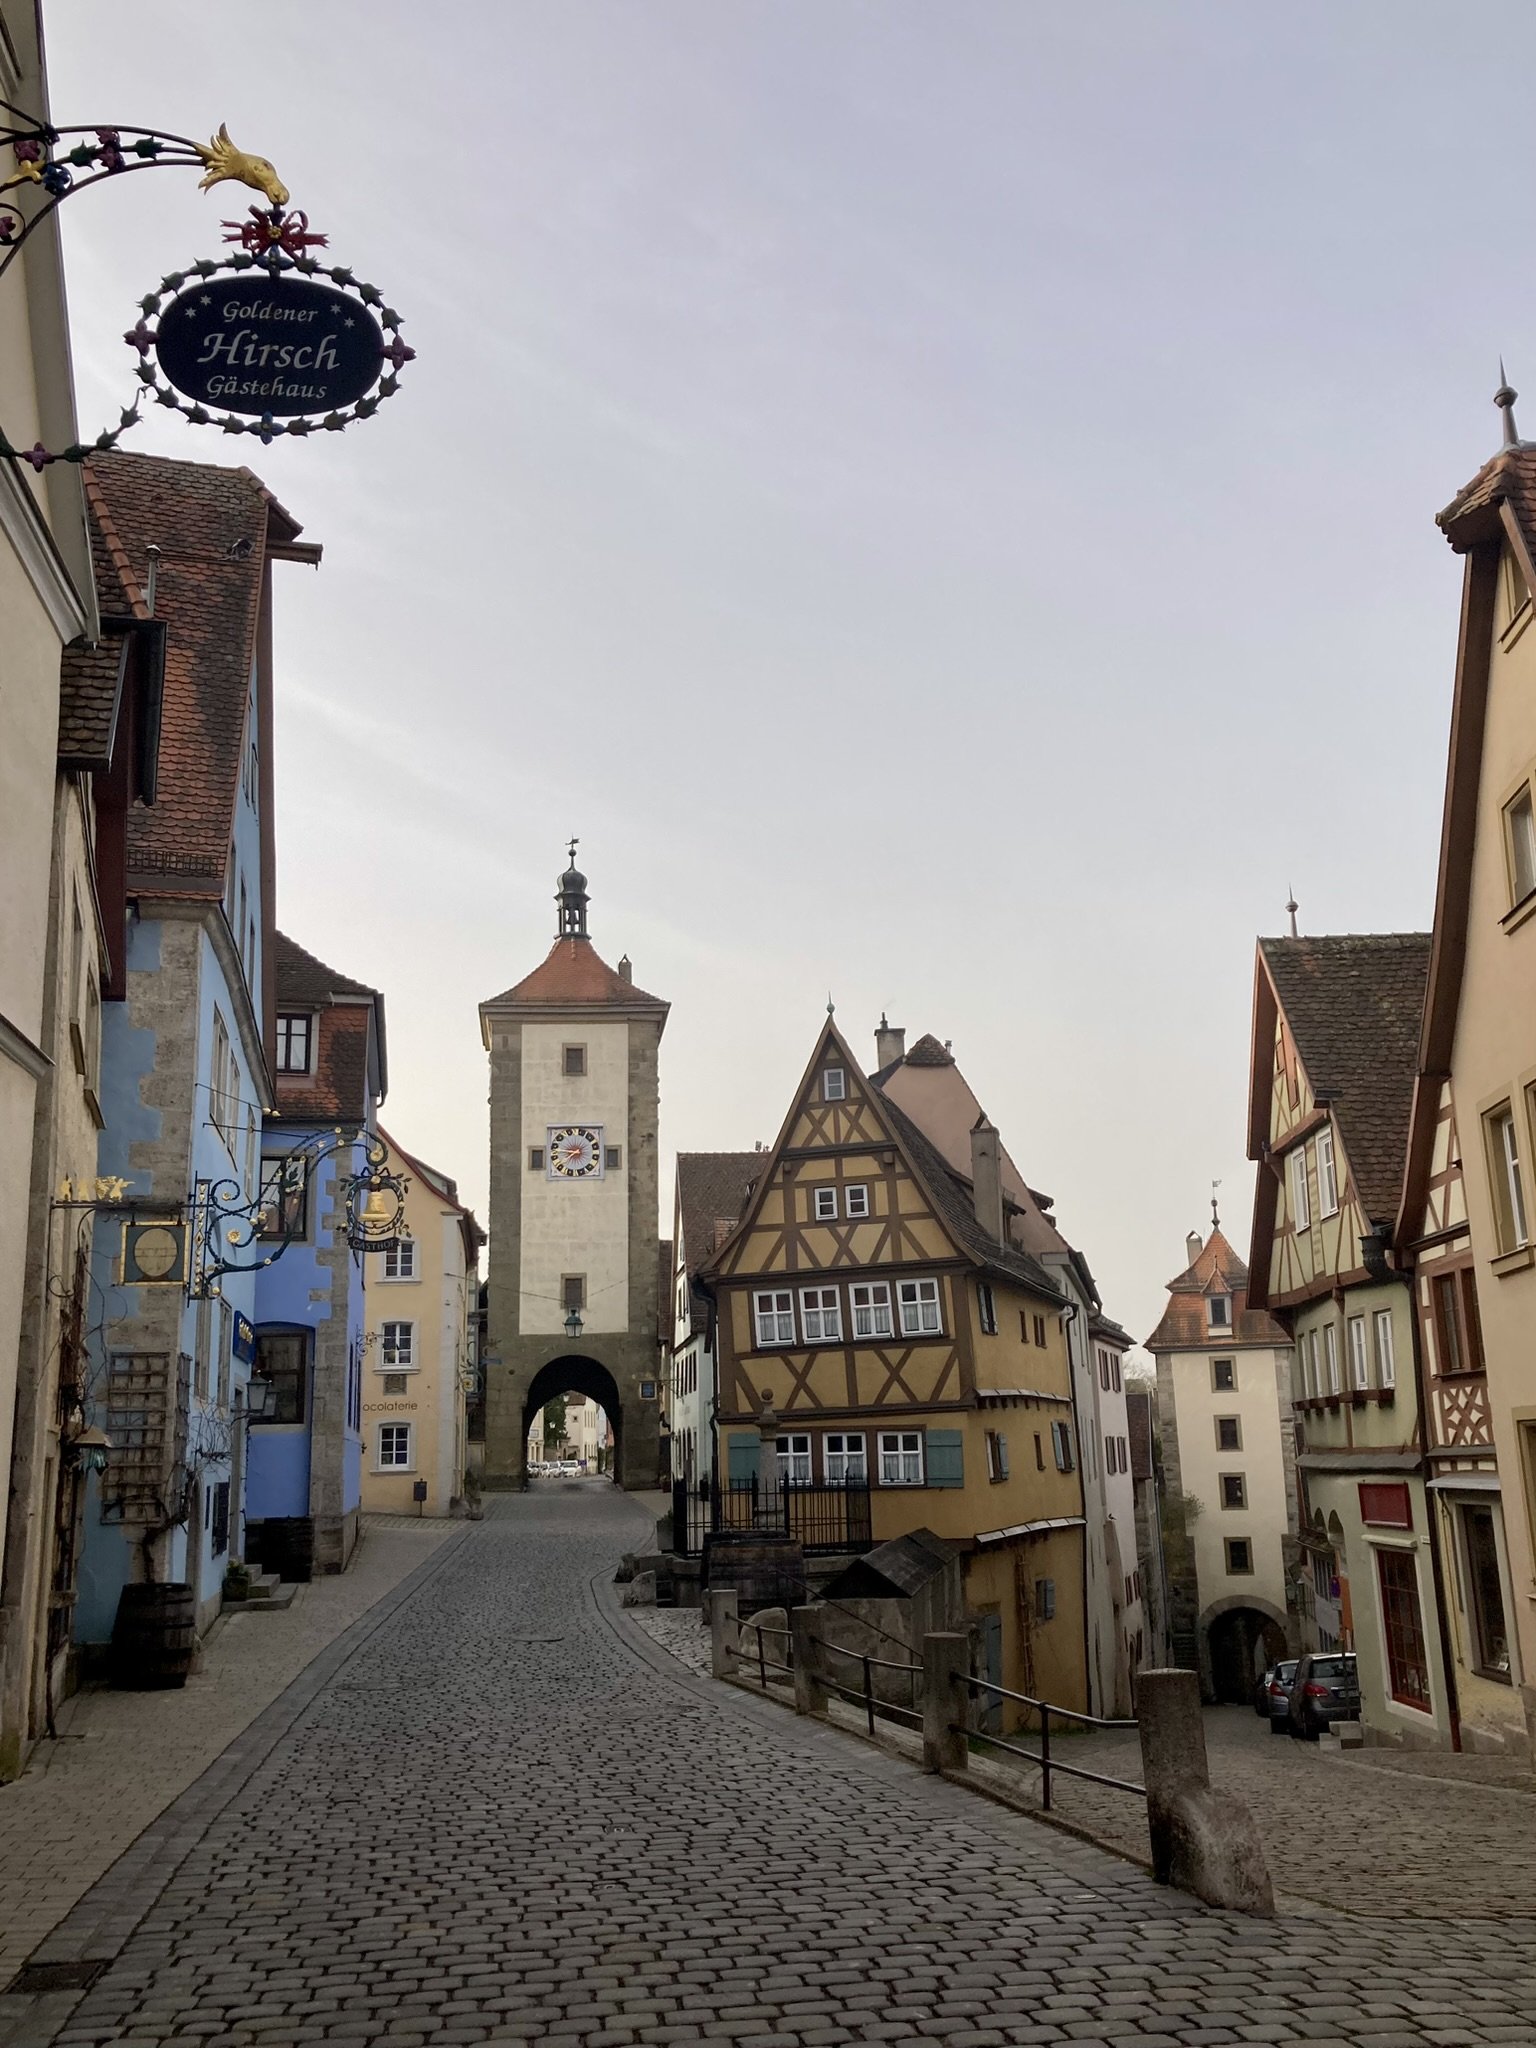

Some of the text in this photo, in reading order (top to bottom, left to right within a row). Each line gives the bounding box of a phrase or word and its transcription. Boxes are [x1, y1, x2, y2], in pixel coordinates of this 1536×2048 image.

[223, 300, 318, 322] Goldener
[197, 330, 340, 370] Hirsch
[206, 375, 327, 399] Gästehaus
